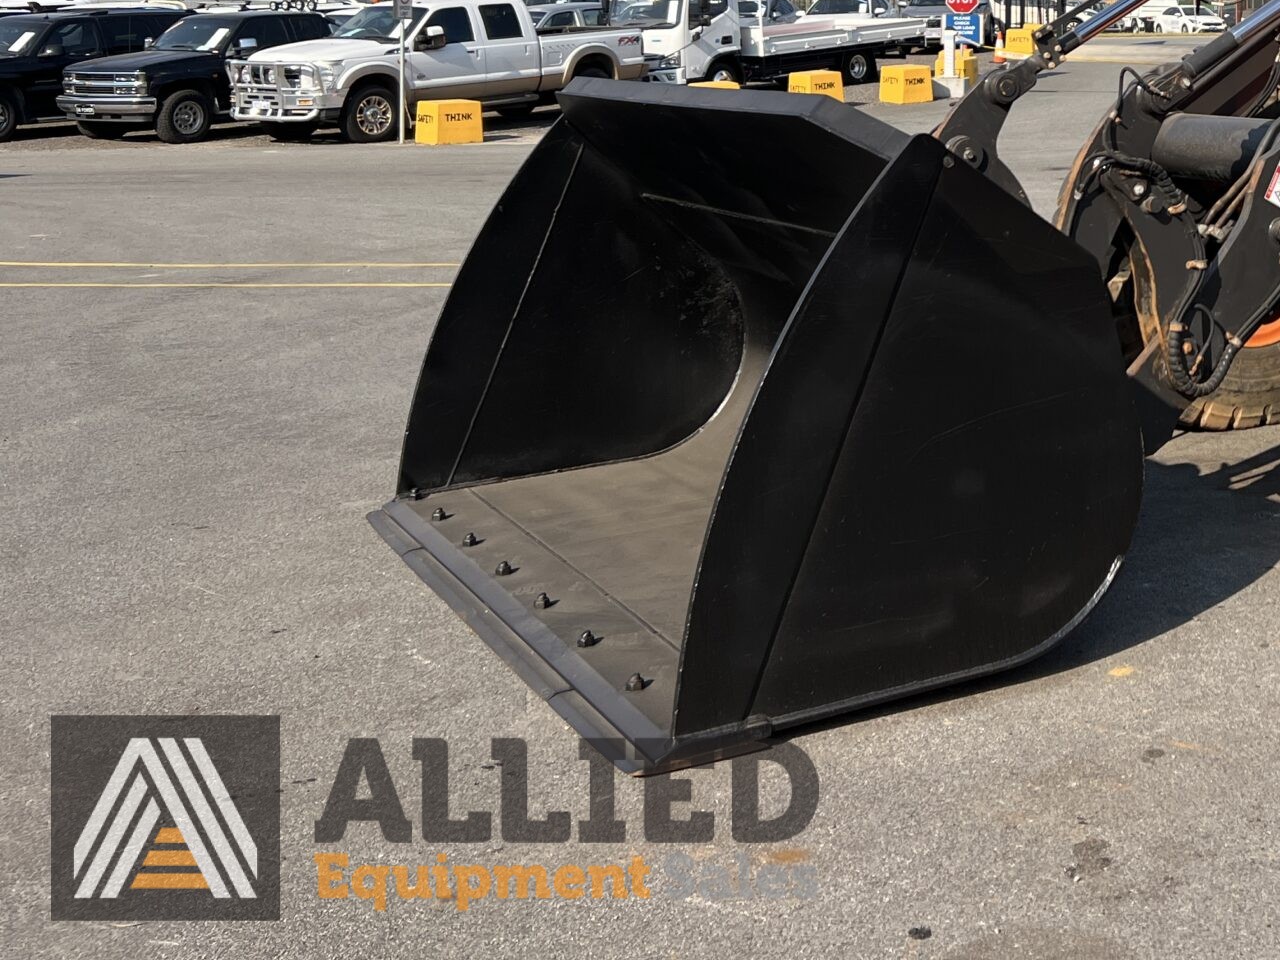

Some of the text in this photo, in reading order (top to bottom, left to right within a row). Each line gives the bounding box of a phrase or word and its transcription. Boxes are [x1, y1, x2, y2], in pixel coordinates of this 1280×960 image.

[618, 36, 641, 46] FX4
[814, 81, 835, 91] THINK
[904, 77, 925, 85] THINK
[445, 112, 473, 123] THINK
